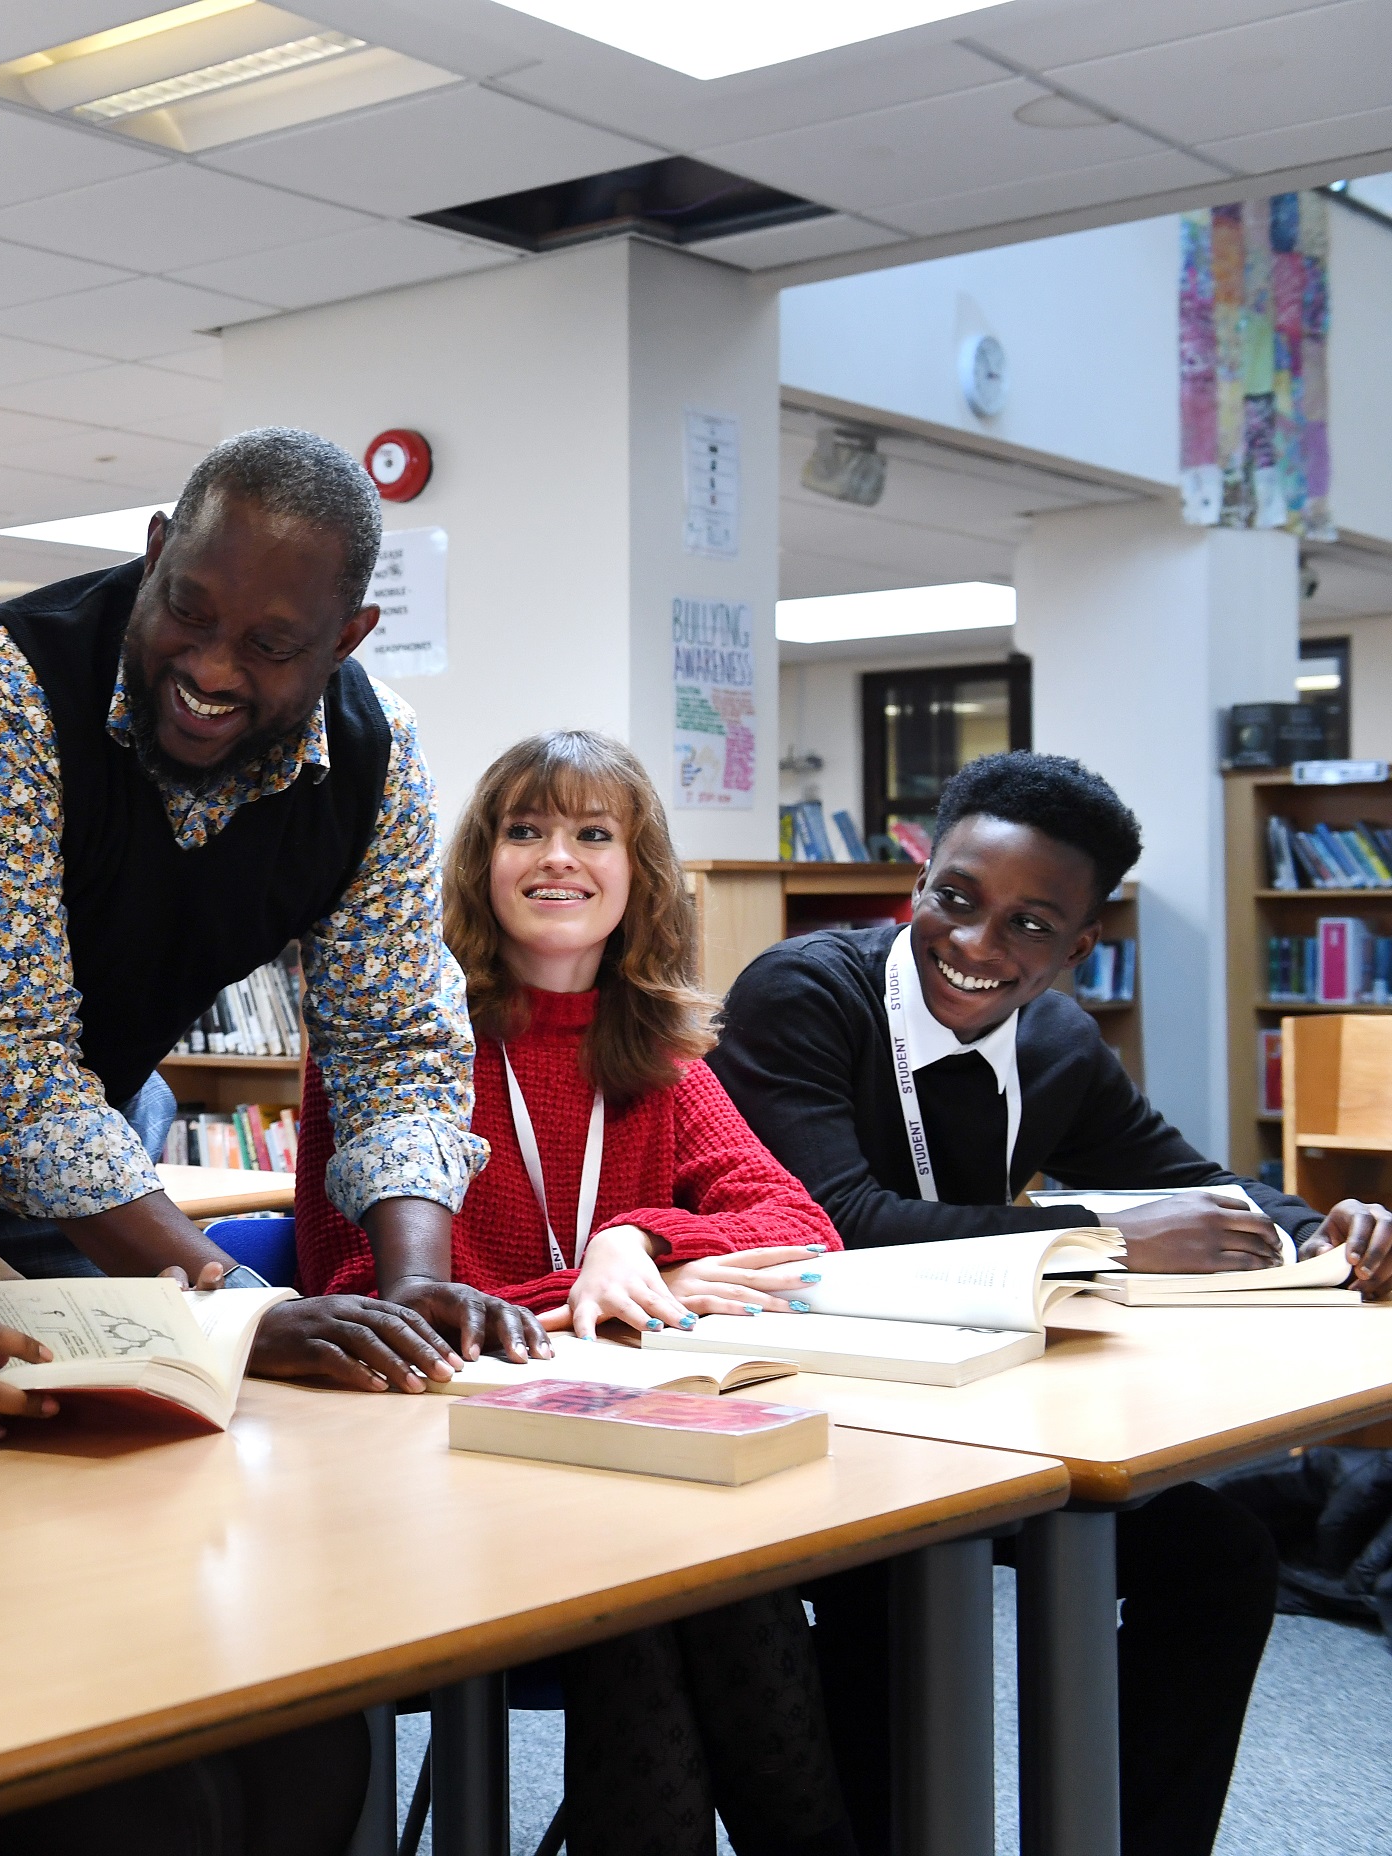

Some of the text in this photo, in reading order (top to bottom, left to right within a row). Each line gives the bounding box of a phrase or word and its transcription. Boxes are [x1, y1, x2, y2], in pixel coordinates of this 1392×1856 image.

[374, 586, 406, 597] MOBILE
[672, 597, 750, 649] BULLYING
[374, 640, 432, 654] HEADPHONES
[674, 646, 754, 687] AWARENESS
[894, 1036, 913, 1094] STUDENT
[909, 1119, 930, 1176] STUDENT
